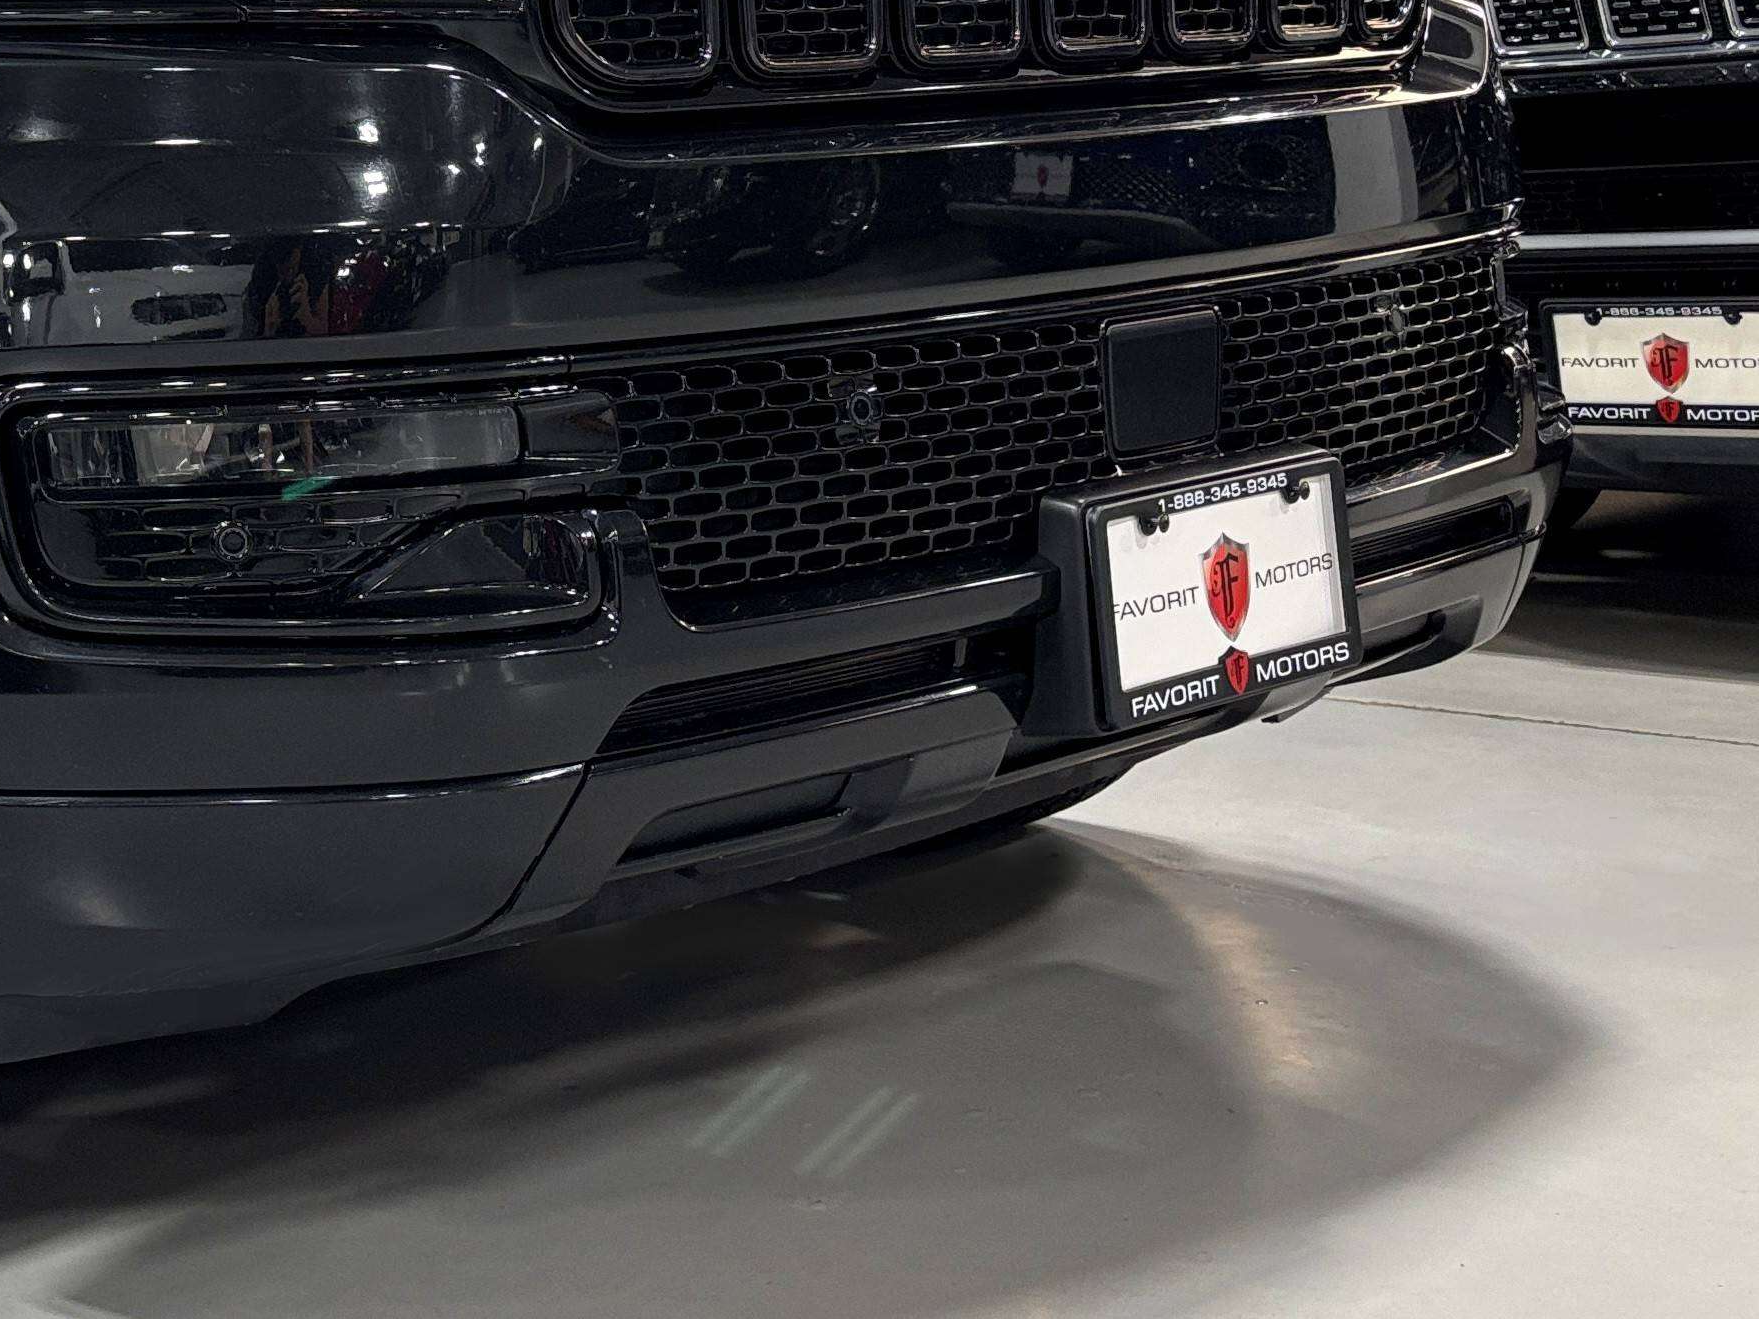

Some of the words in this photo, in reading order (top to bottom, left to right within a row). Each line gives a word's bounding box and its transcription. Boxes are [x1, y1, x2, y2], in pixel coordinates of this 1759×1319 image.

[1561, 357, 1639, 368] FAVORIT
[1695, 357, 1759, 369] MOTO
[1567, 407, 1651, 420] FAVORIT
[1158, 472, 1288, 512] 1-888-345-9345
[1255, 553, 1333, 588] MOTORS
[1131, 674, 1220, 718] FAVORIT
[1256, 642, 1350, 683] MOTORS
